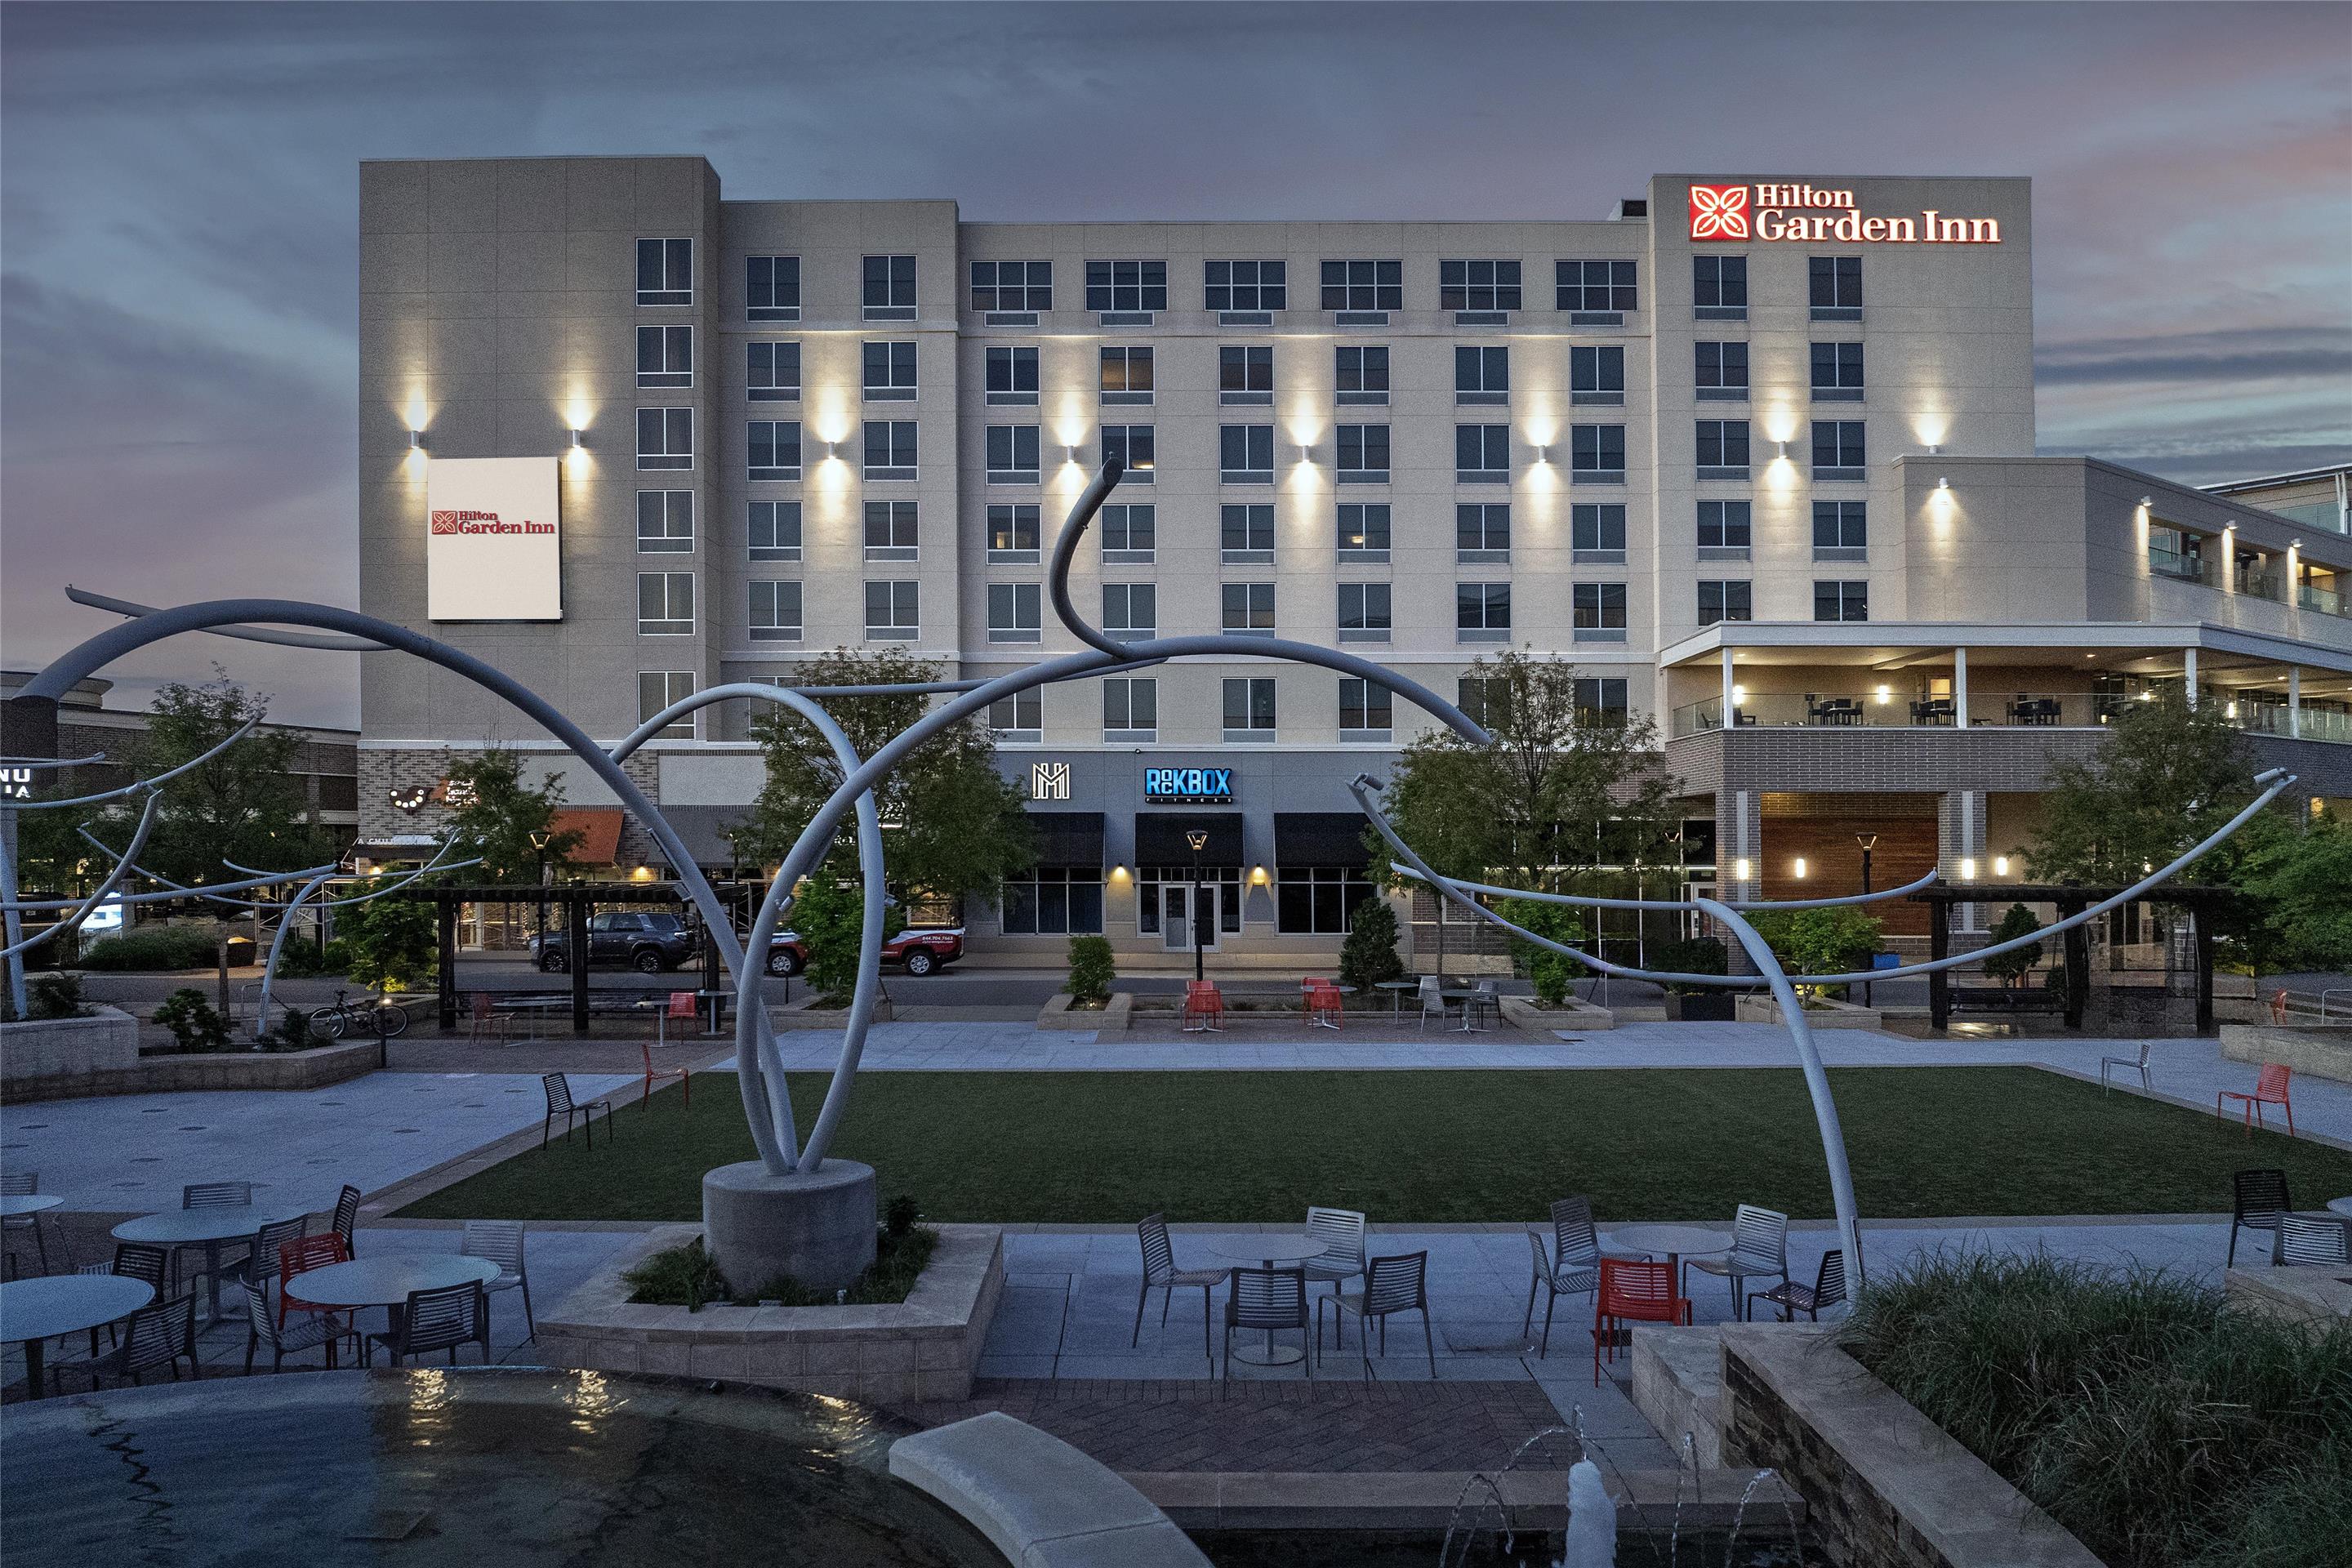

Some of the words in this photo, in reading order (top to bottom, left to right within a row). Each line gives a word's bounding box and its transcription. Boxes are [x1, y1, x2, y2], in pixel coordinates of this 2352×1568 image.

[1755, 184, 1855, 208] Hilton
[1755, 209, 1918, 242] Garden
[1922, 210, 2001, 243] Inn
[458, 510, 498, 521] Hilton
[458, 521, 523, 534] Garden
[523, 520, 555, 534] Inn
[1146, 768, 1232, 795] ROCKBOX
